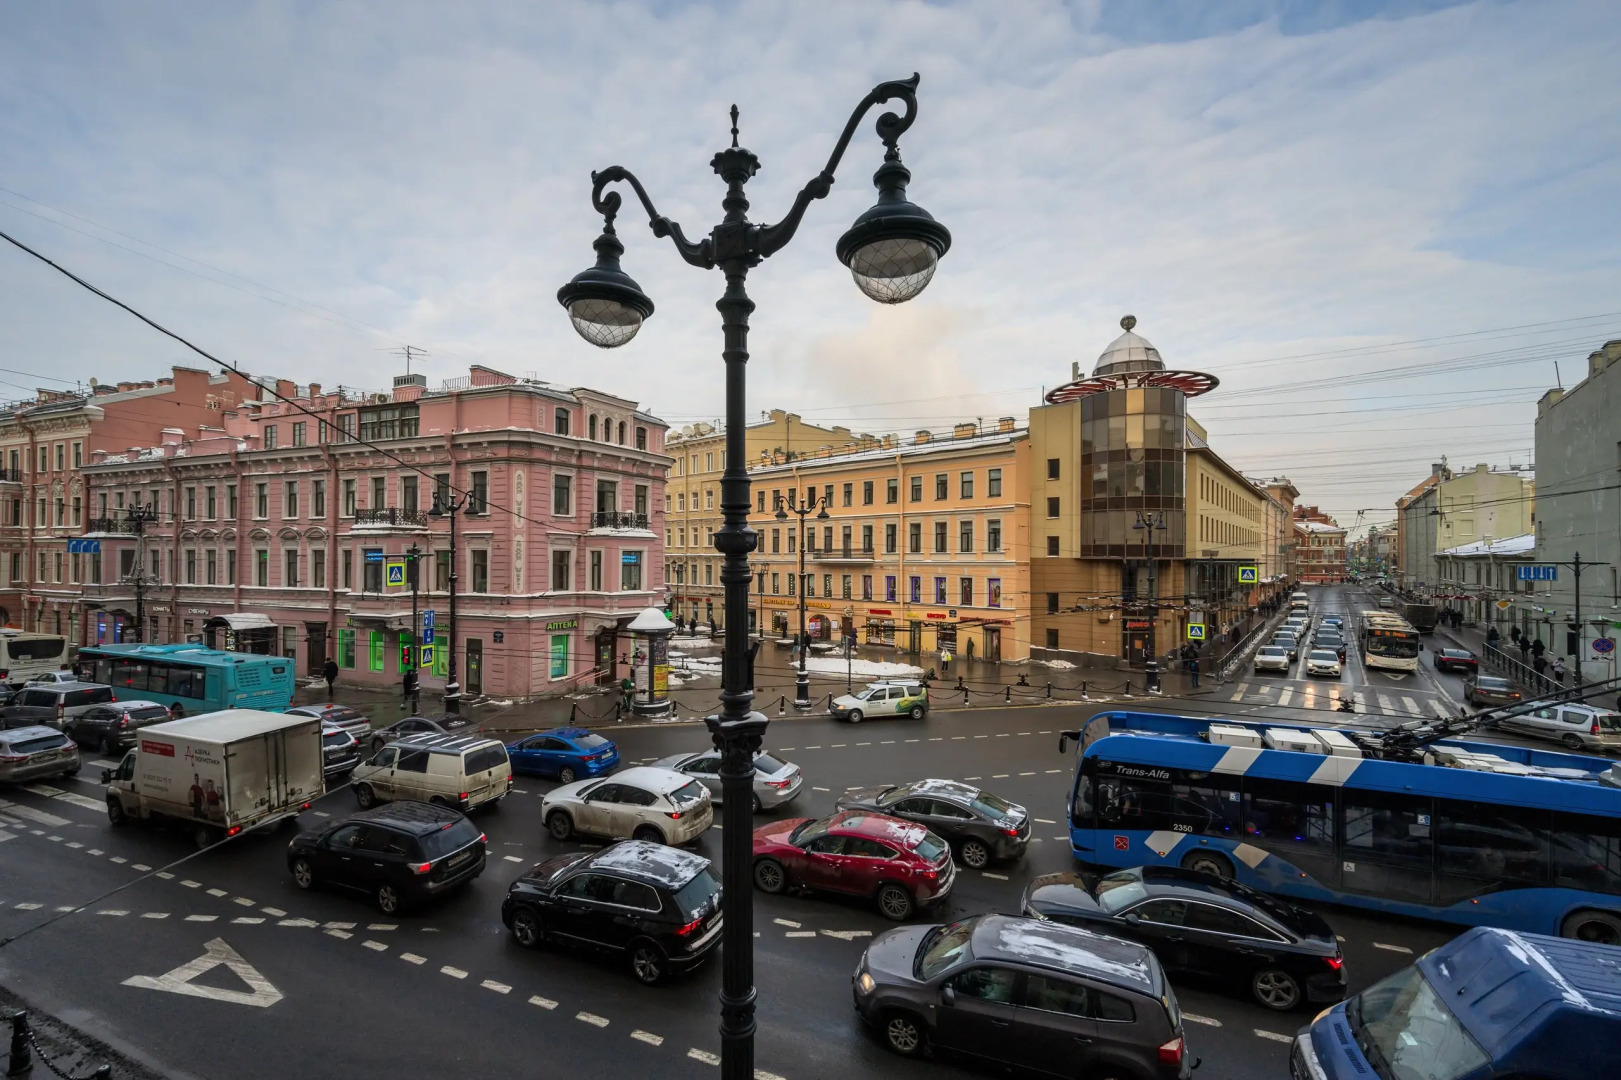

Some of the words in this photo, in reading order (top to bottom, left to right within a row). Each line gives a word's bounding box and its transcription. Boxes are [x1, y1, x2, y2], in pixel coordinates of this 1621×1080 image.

[547, 620, 578, 631] АПТЕКА
[1116, 765, 1169, 779] Trans-Alfa
[1173, 823, 1192, 832] 2350
